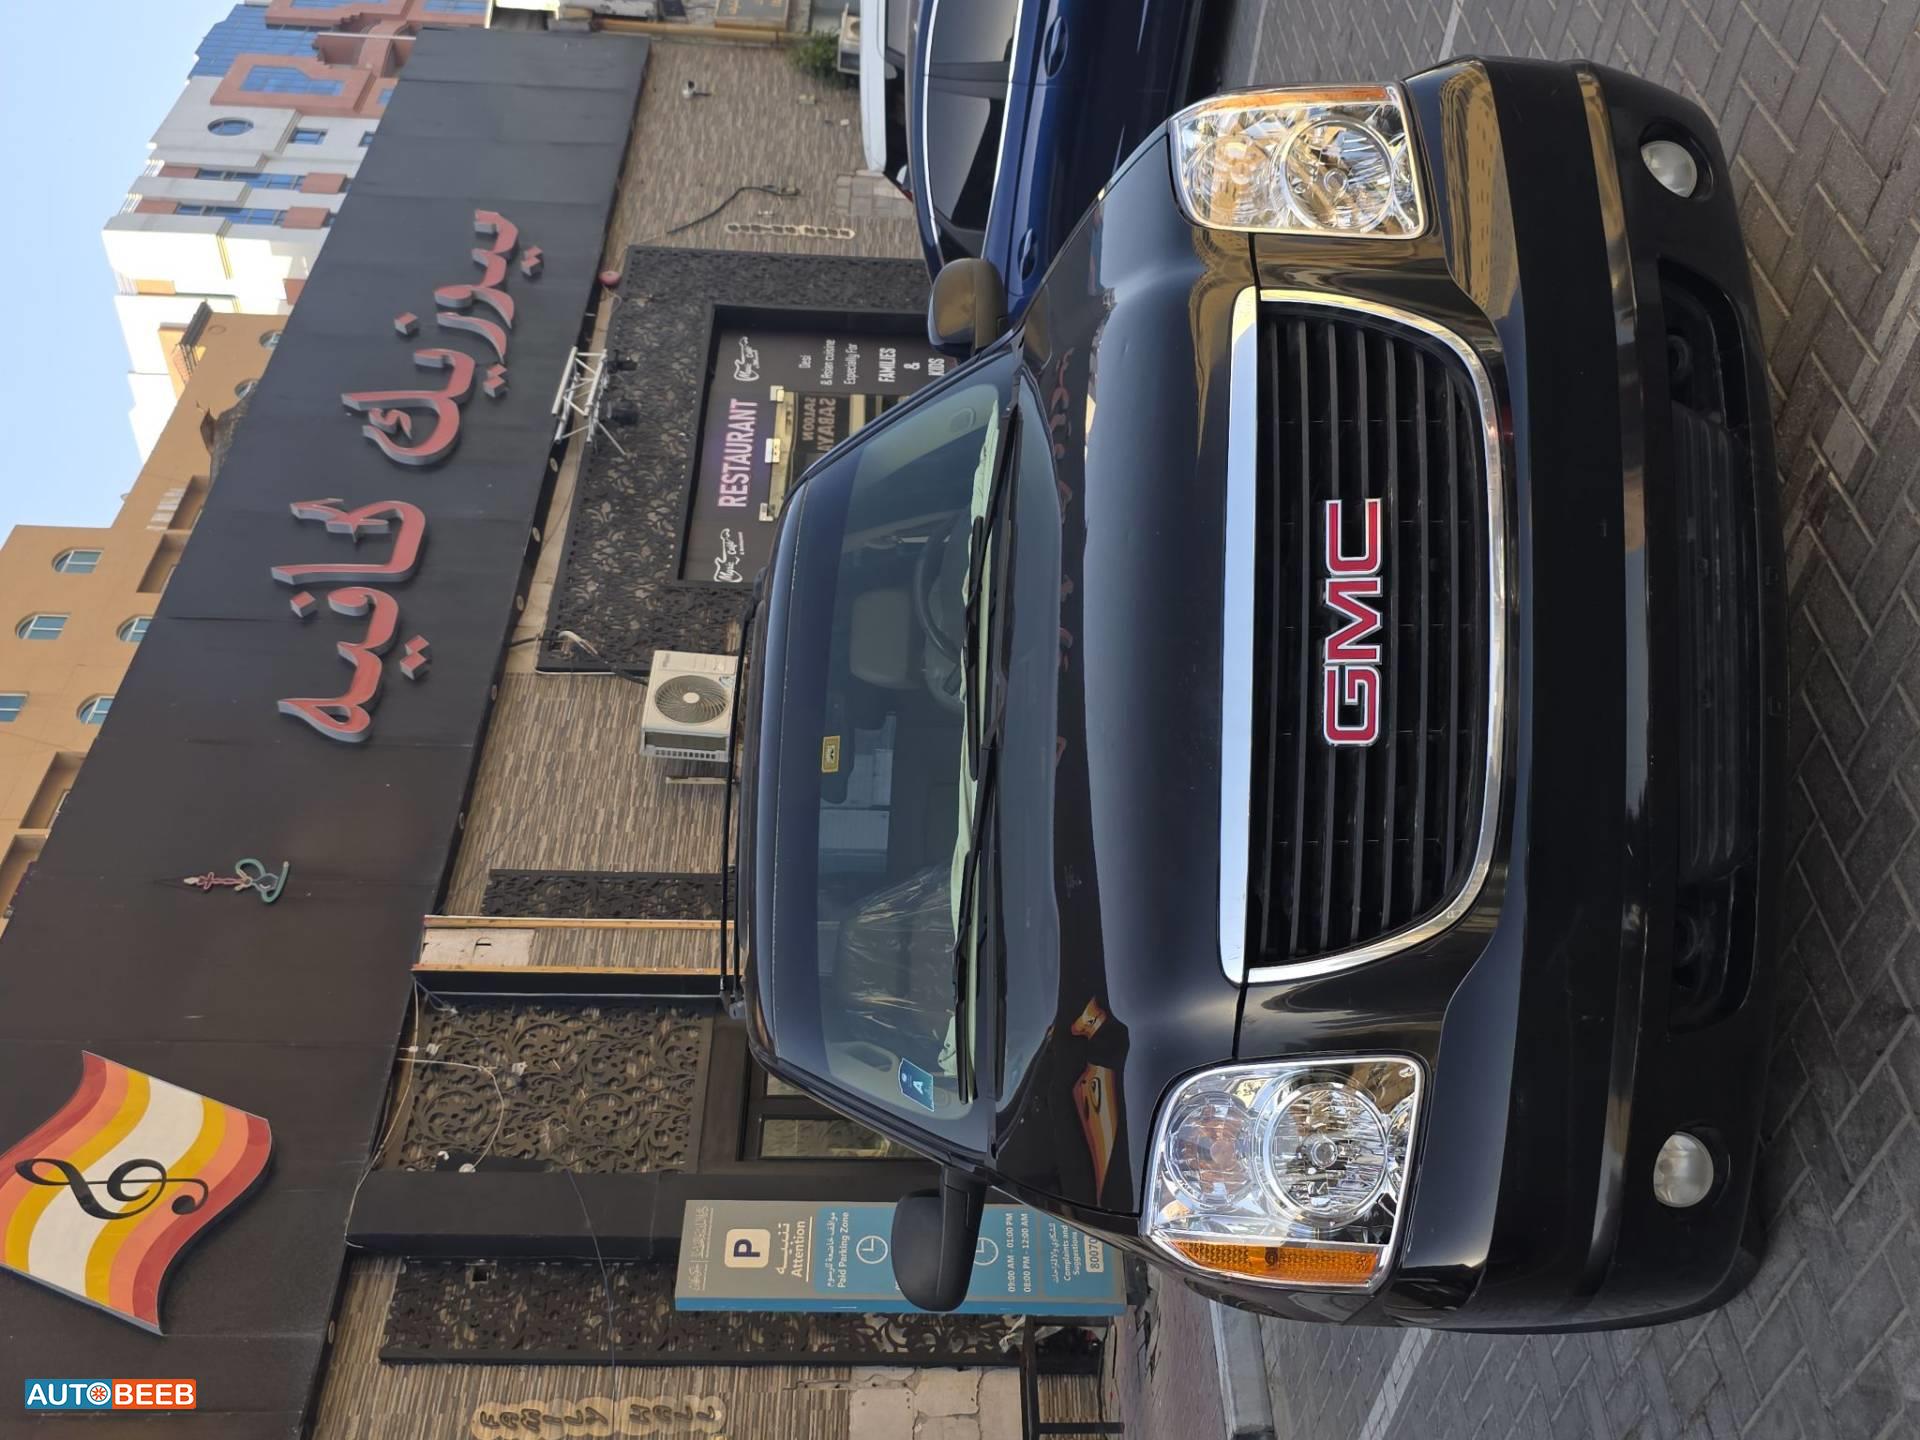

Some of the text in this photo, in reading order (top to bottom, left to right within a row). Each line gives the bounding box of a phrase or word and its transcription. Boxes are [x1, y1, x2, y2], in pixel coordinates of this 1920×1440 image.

[824, 339, 836, 361] cuisine
[878, 347, 896, 383] FAMILIES
[821, 361, 834, 379] Asian
[843, 354, 860, 385] Especially
[903, 362, 920, 370] &
[928, 358, 945, 376] KIDS
[717, 398, 758, 508] RESTAURANT
[271, 498, 430, 743] كافيه
[1323, 498, 1382, 746] GMC
[912, 1080, 924, 1095] A
[1005, 1213, 1014, 1226] PM
[1020, 1213, 1029, 1227] AM
[733, 1239, 760, 1258] P
[775, 1223, 796, 1275] تنبيه
[791, 1221, 806, 1278] Attention
[837, 1212, 850, 1288] Paid Parking Zone
[1007, 1255, 1015, 1269] AM
[1022, 1256, 1031, 1269] PM
[1060, 1224, 1072, 1281] Complaints and
[1072, 1232, 1082, 1275] Suggestions
[479, 1403, 716, 1433] FAMILY HALL
